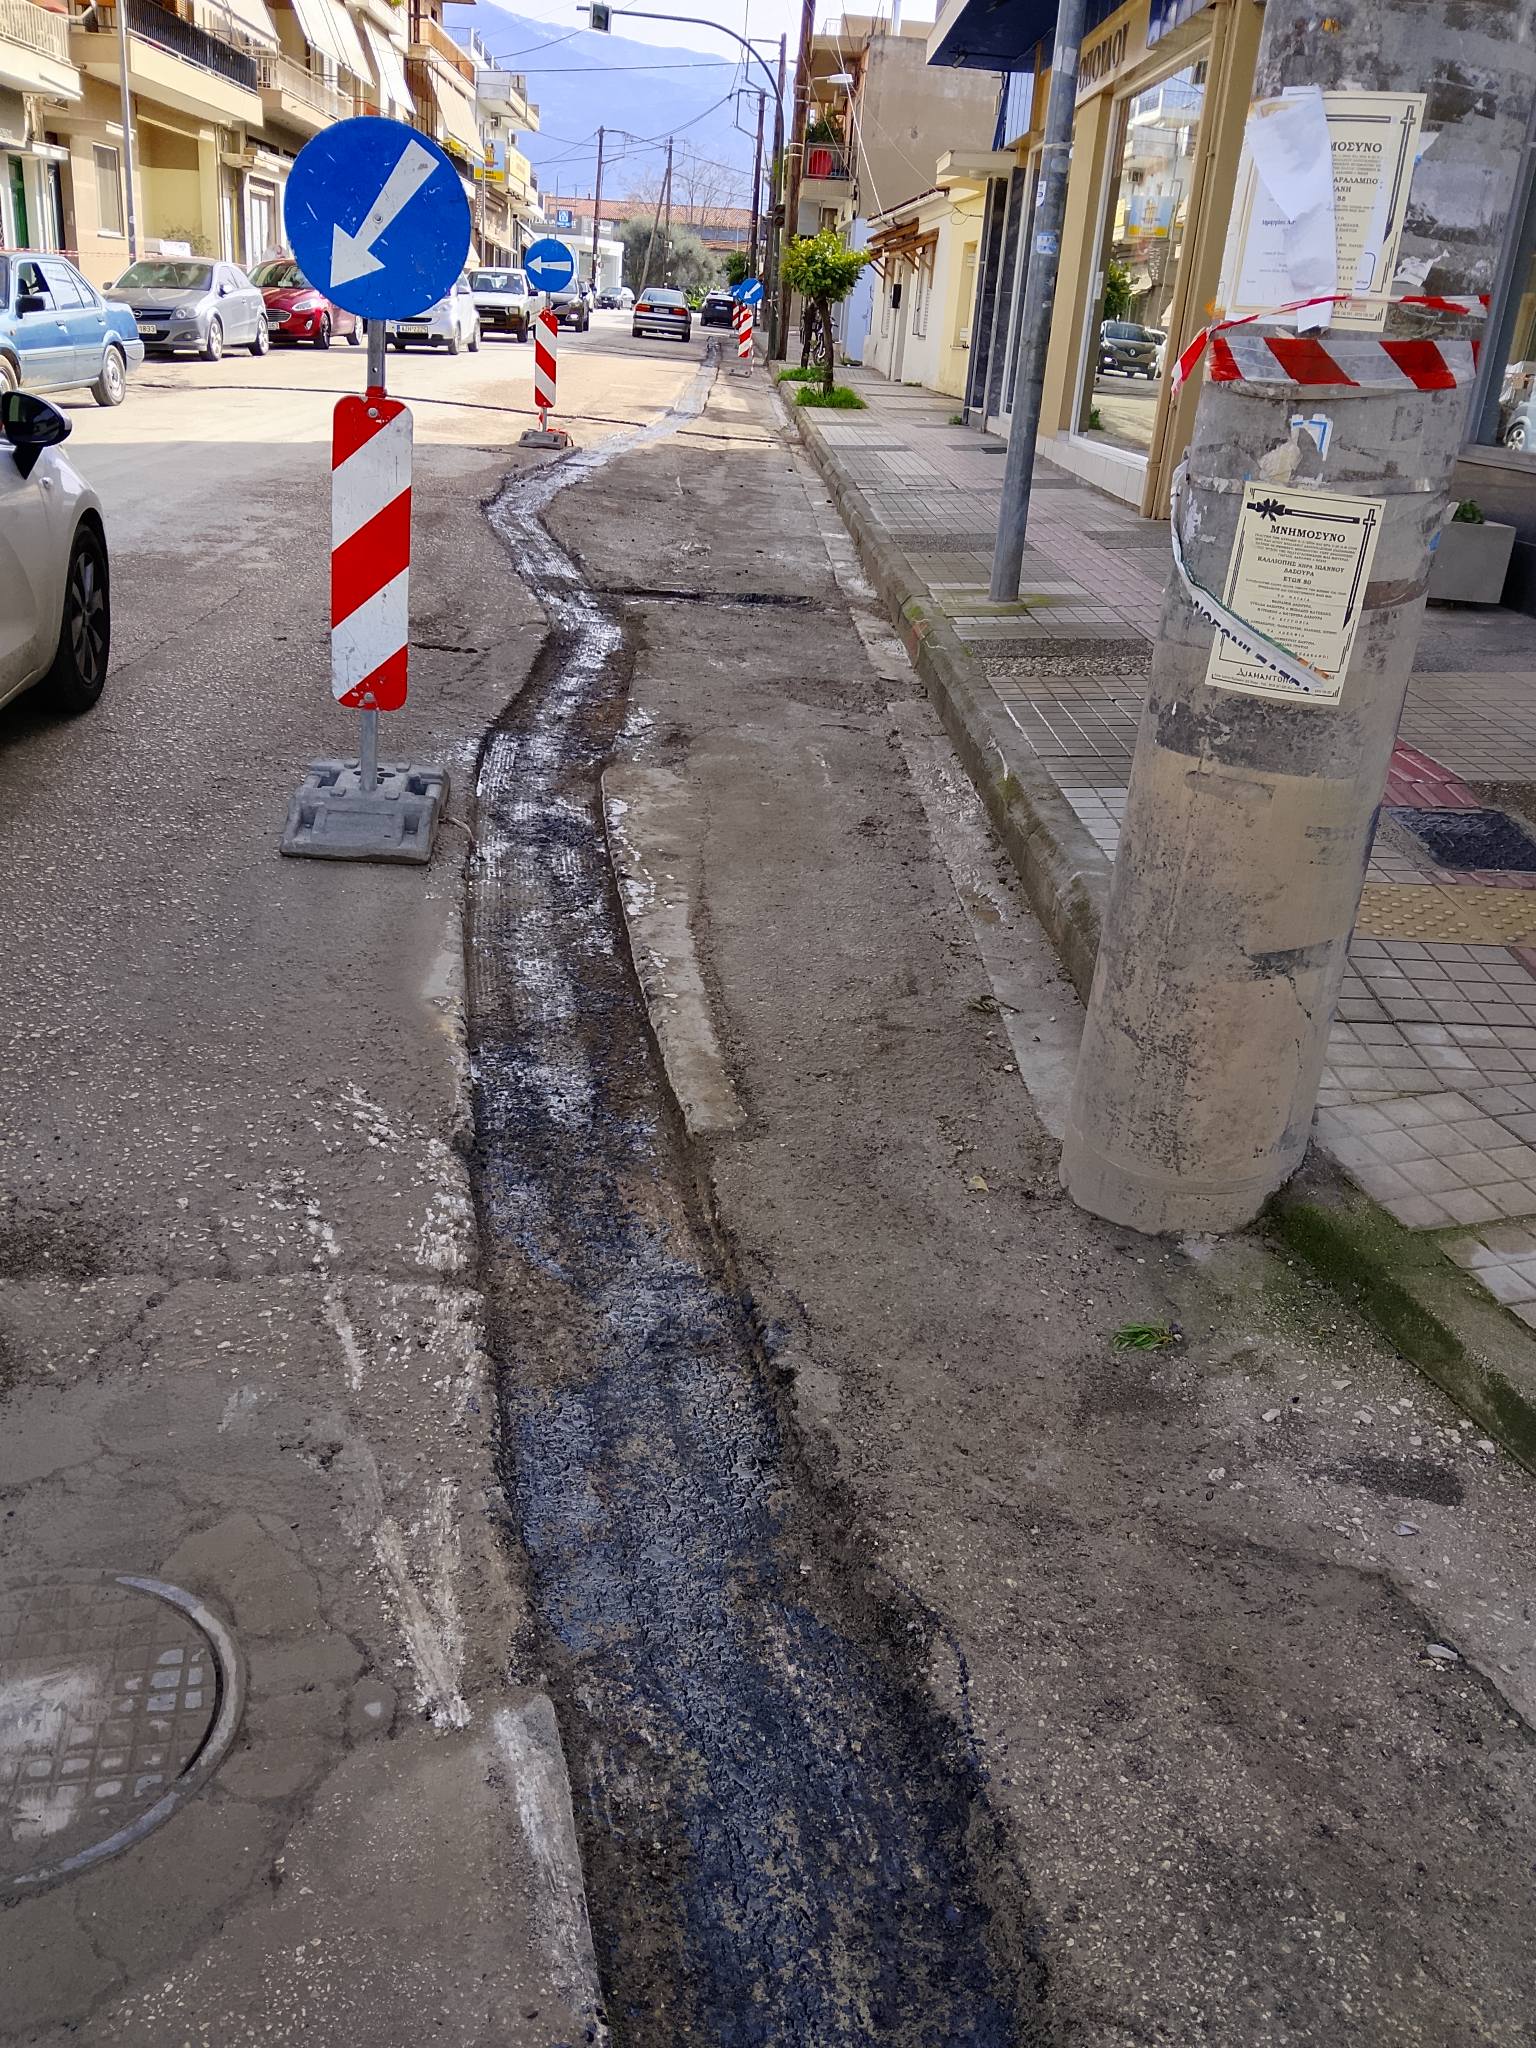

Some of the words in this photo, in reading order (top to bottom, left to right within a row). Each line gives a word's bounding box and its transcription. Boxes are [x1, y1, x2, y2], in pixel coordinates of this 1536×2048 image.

[1333, 176, 1379, 185] ΑΡΑΛΑΜΠΟ
[1270, 524, 1346, 543] ΜΝΗΜΟΣΥΝΟ
[1257, 556, 1297, 567] ΚΑΛΛΙΟΠΗΣ
[1314, 564, 1345, 574] ΙΩΑΝΝΟΥ
[1283, 576, 1301, 584] ΕΤΩΝ
